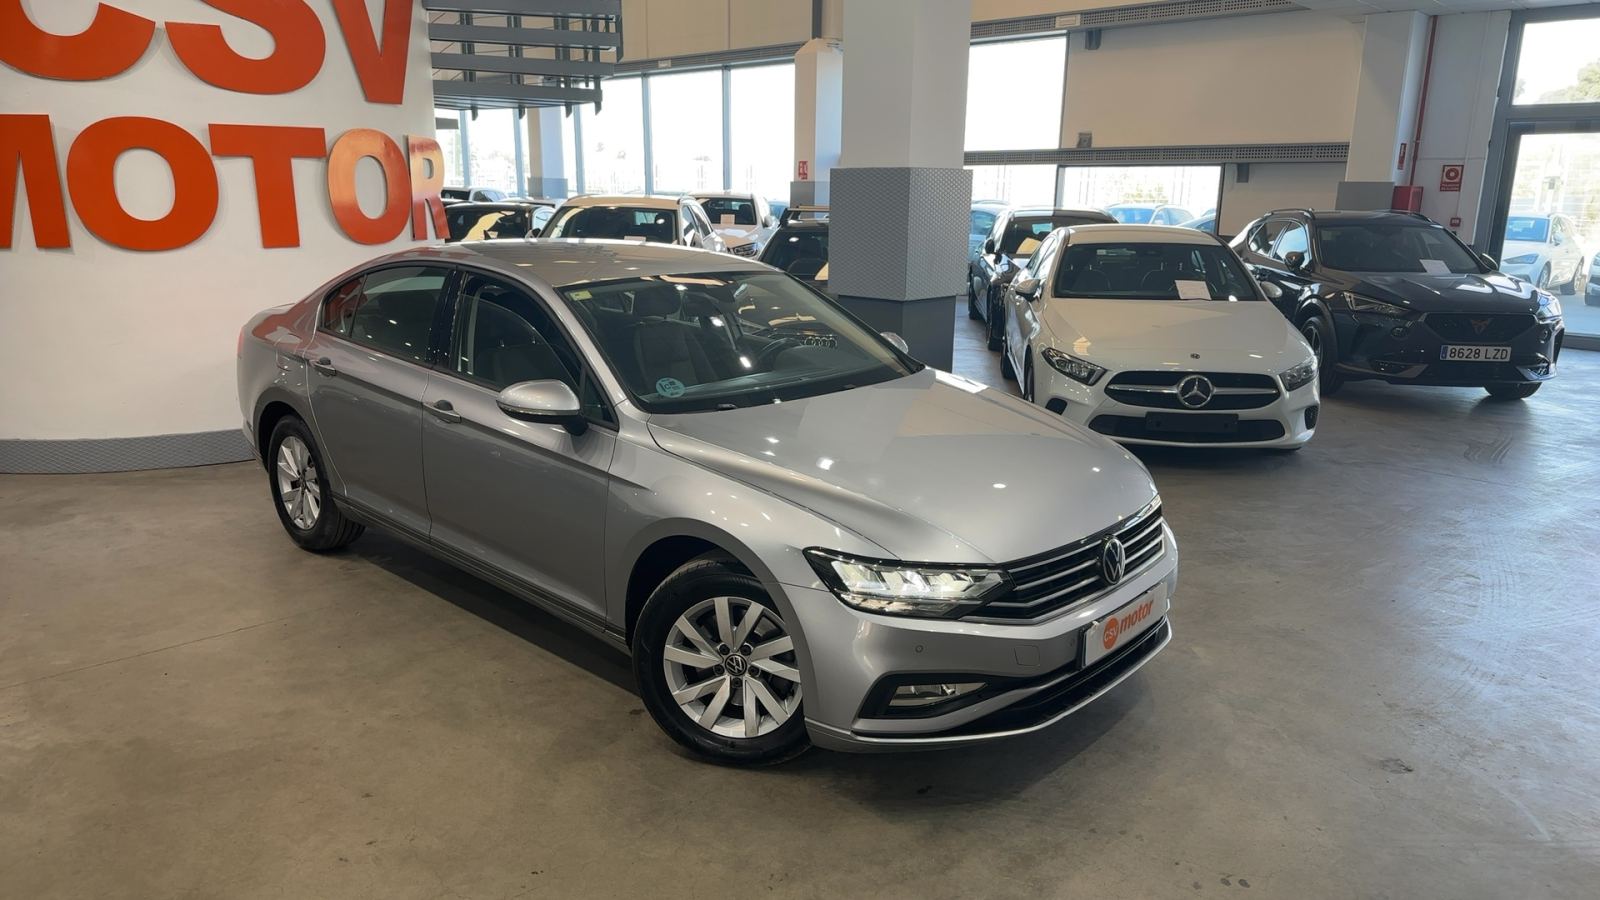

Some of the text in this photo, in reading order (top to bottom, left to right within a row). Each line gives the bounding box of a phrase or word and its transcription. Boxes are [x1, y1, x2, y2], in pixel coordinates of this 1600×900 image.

[1449, 347, 1508, 360] 8628 LZD
[1120, 599, 1154, 634] motor
